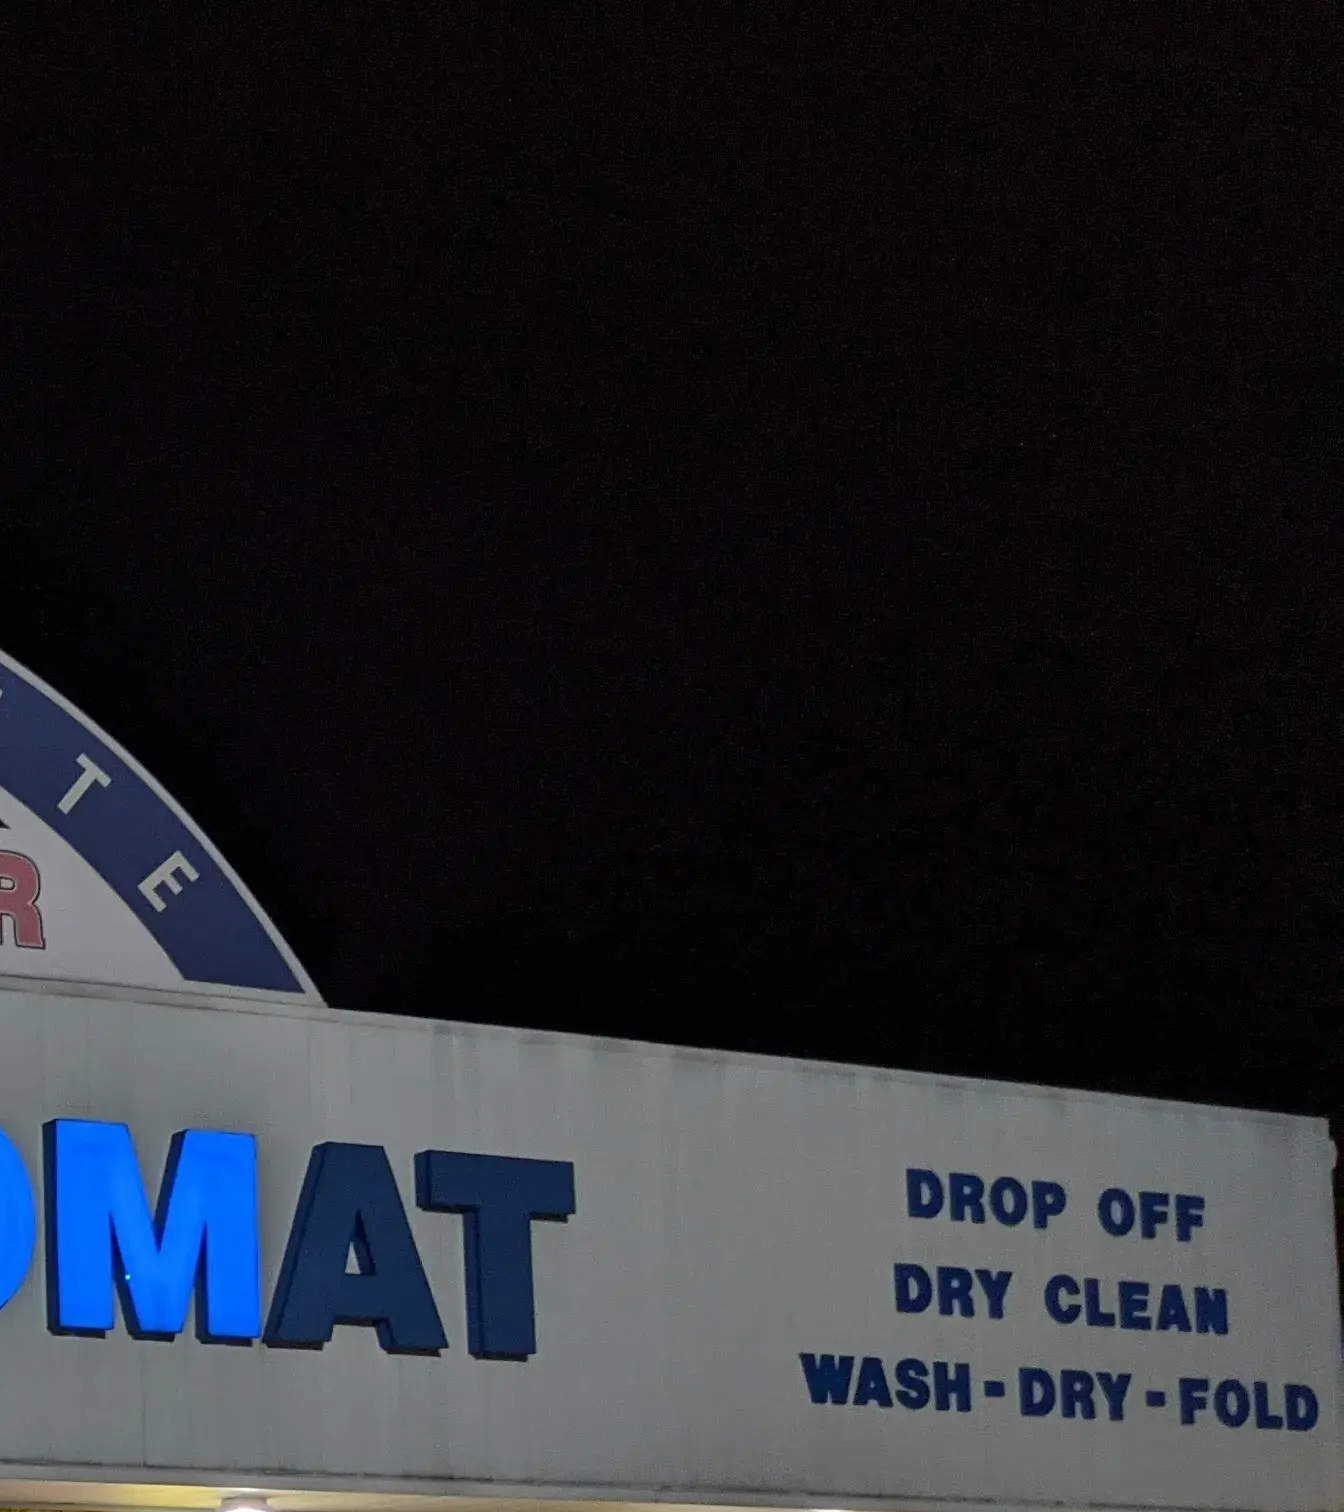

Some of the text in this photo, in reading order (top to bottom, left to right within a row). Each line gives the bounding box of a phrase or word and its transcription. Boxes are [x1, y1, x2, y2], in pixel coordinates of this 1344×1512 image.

[906, 1168, 1206, 1242] DROP OFF
[893, 1262, 1229, 1335] DRY CLEAN
